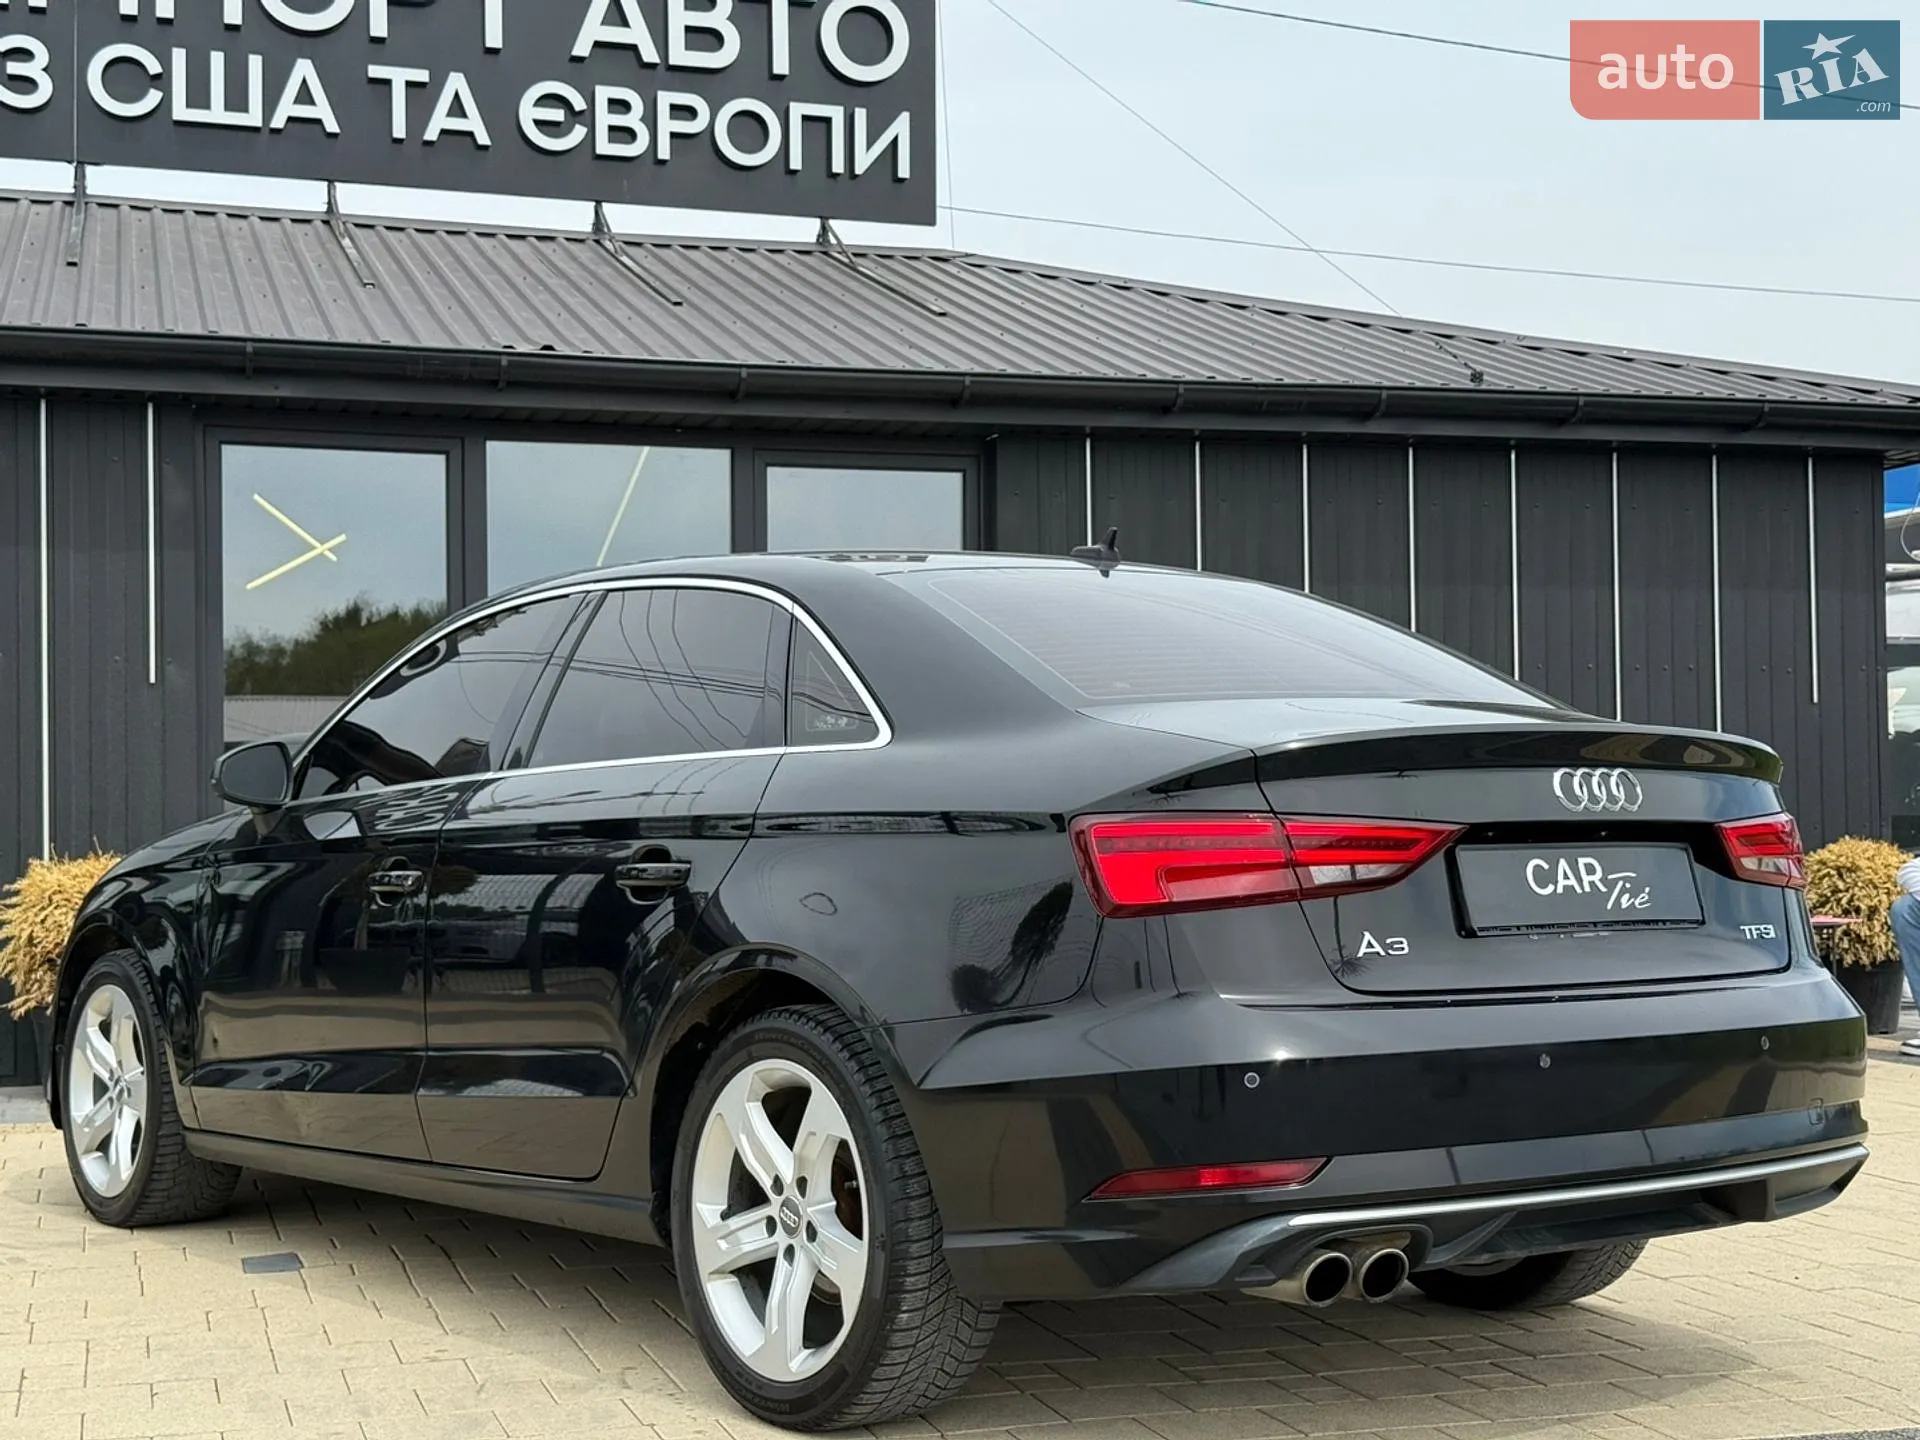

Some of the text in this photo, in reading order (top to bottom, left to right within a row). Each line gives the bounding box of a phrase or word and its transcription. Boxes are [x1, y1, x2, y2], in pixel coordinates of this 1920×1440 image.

[570, 0, 910, 84] АВТО
[87, 43, 341, 135] США
[367, 64, 492, 147] ТА
[518, 80, 911, 181] ЄВРОПИ
[1525, 856, 1607, 896] CAR
[1357, 931, 1410, 957] A3
[1740, 924, 1776, 941] TFSI
